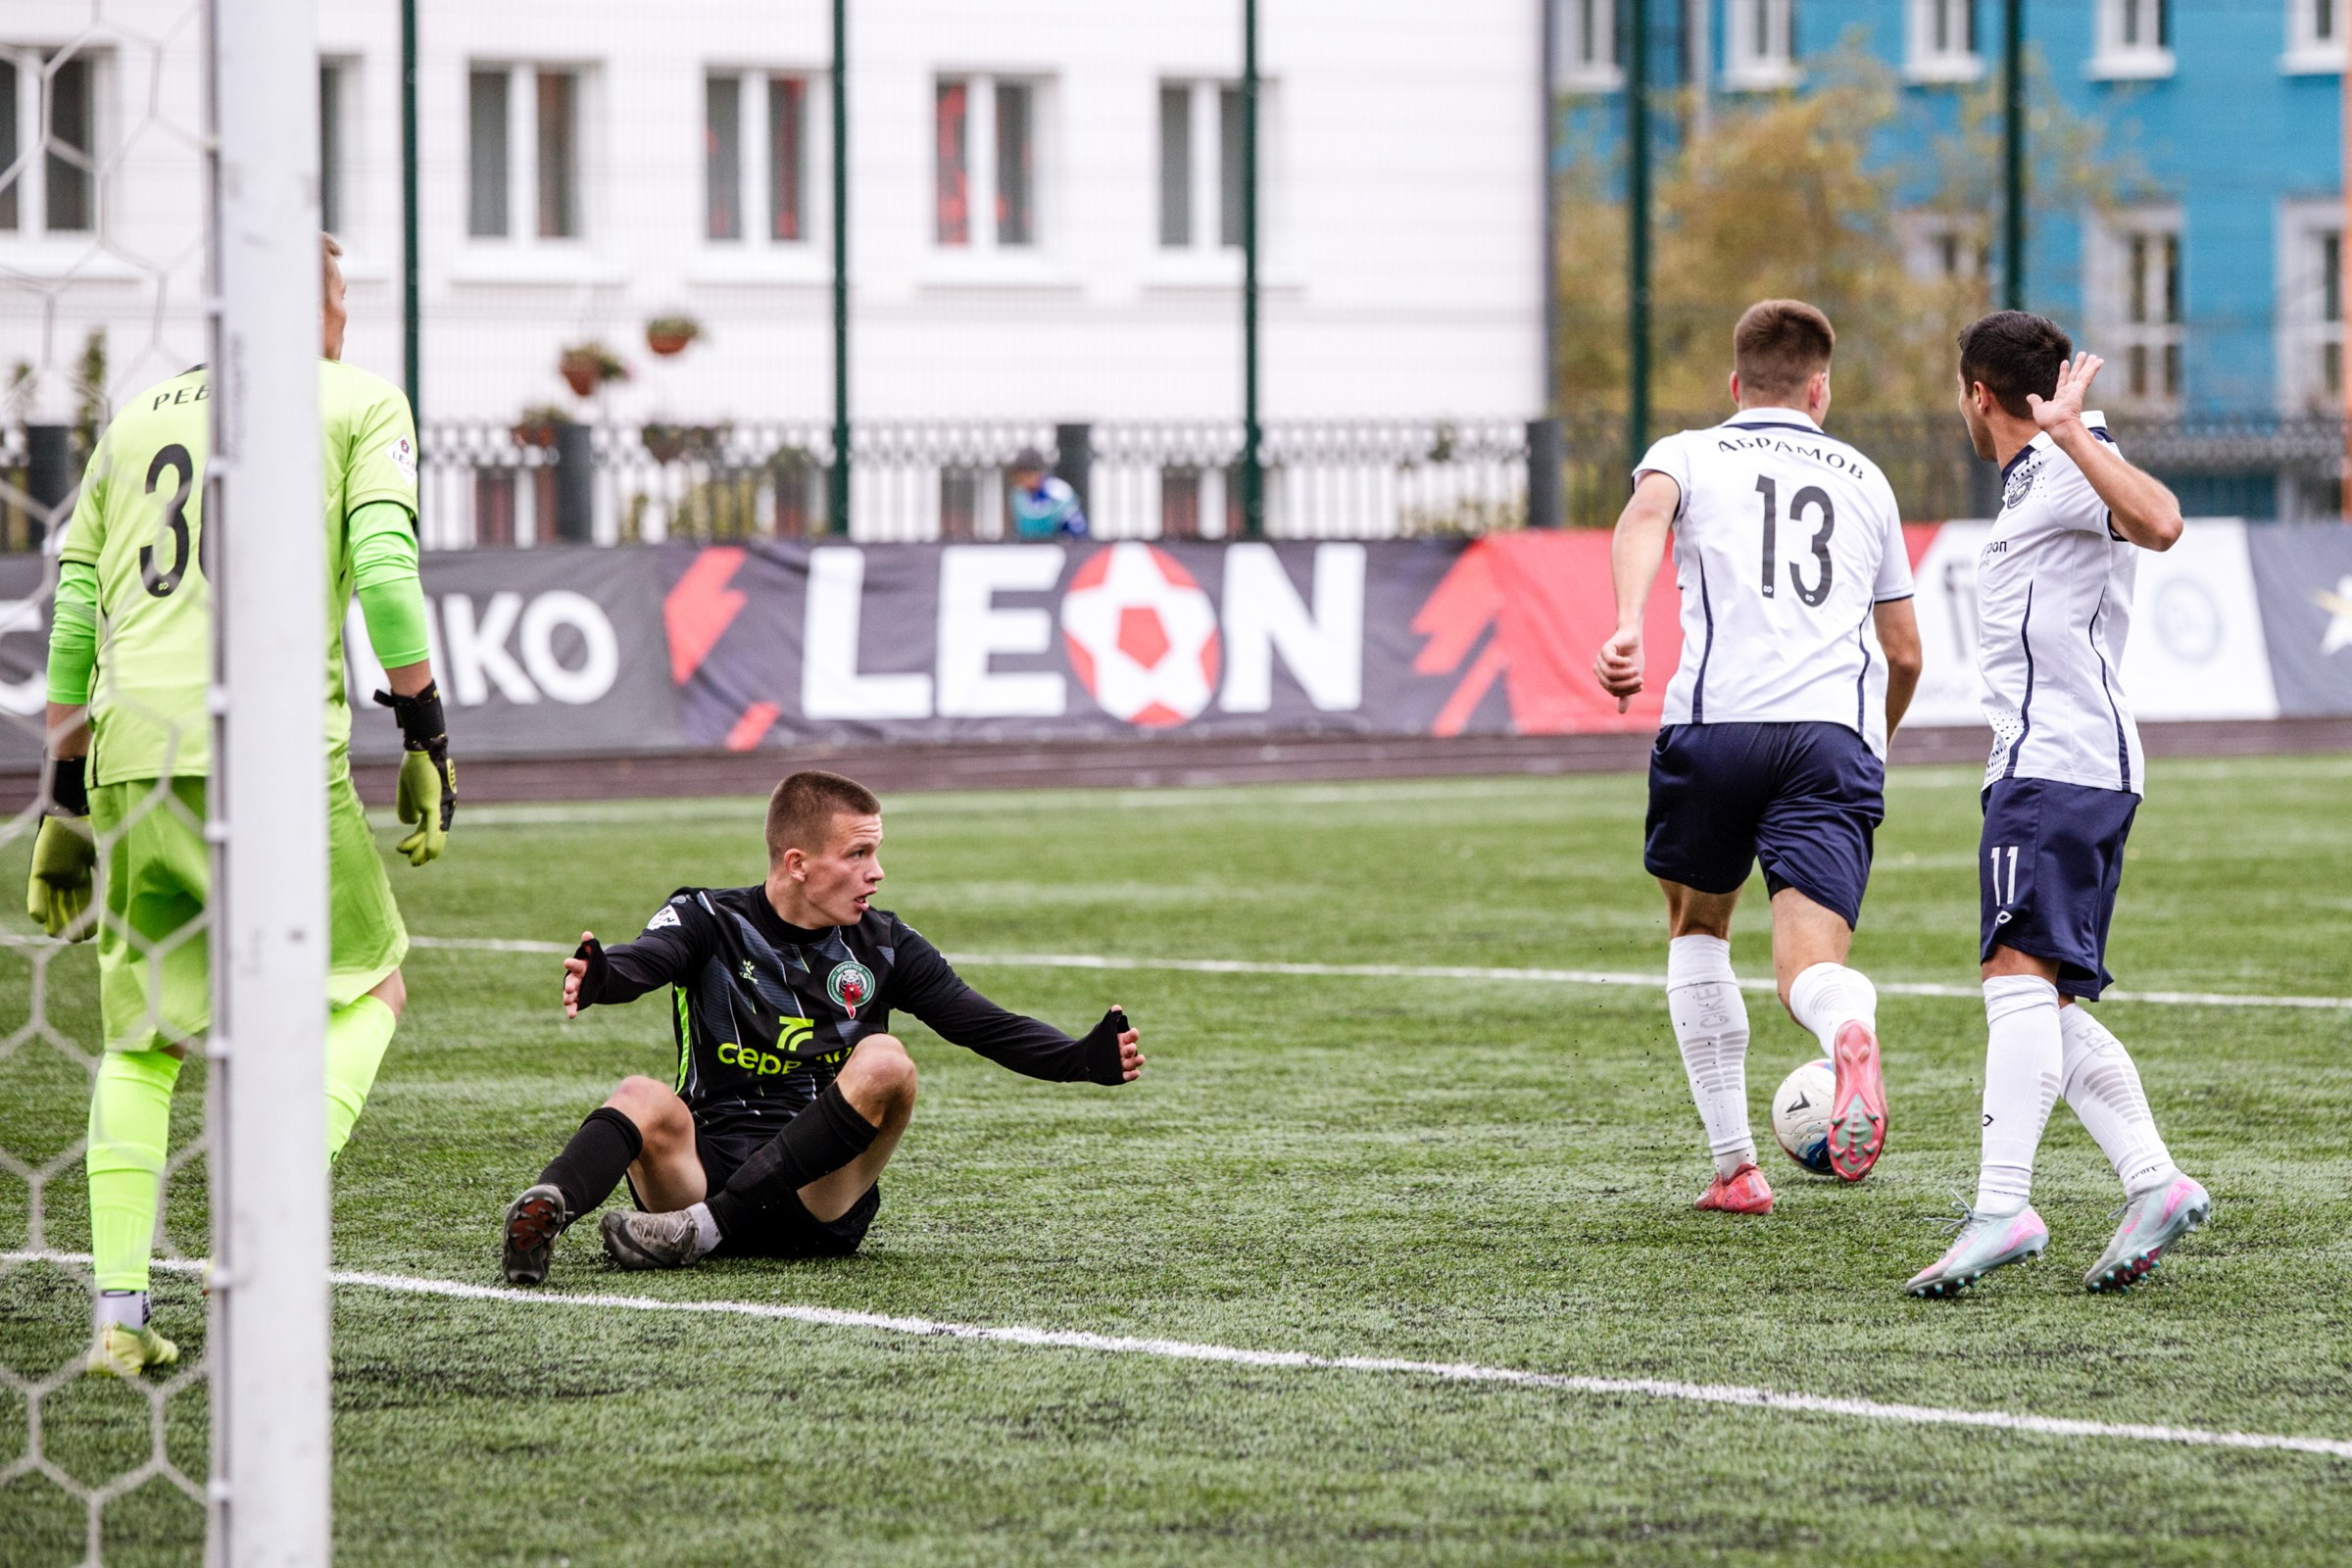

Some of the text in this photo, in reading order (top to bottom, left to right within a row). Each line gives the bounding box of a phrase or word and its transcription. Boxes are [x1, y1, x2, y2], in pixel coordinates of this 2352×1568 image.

[139, 443, 210, 598] 3
[1718, 437, 1863, 479] АБРАМОВ
[1755, 473, 1835, 608] 13
[802, 542, 1366, 726] LEON
[1990, 846, 2019, 907] 11
